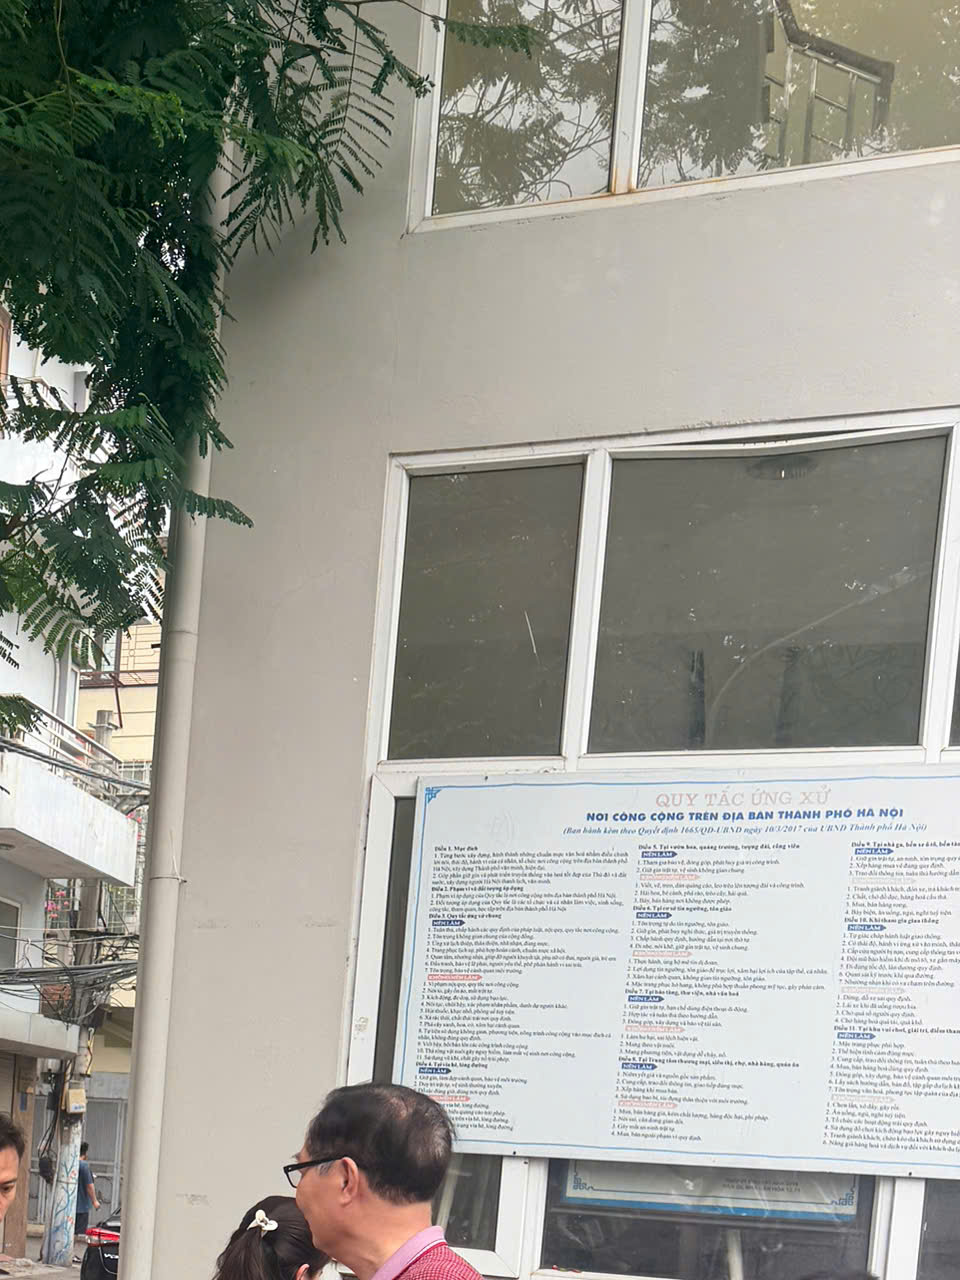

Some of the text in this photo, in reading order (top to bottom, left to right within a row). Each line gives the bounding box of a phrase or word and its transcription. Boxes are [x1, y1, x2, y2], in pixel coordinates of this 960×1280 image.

[655, 792, 698, 808] QUY
[704, 785, 745, 807] TẮC
[612, 810, 647, 822] CÔNG
[650, 809, 685, 824] CỘNG
[688, 810, 719, 821] TRÊN
[721, 811, 745, 824] ĐỊA
[878, 806, 904, 820] NỘI
